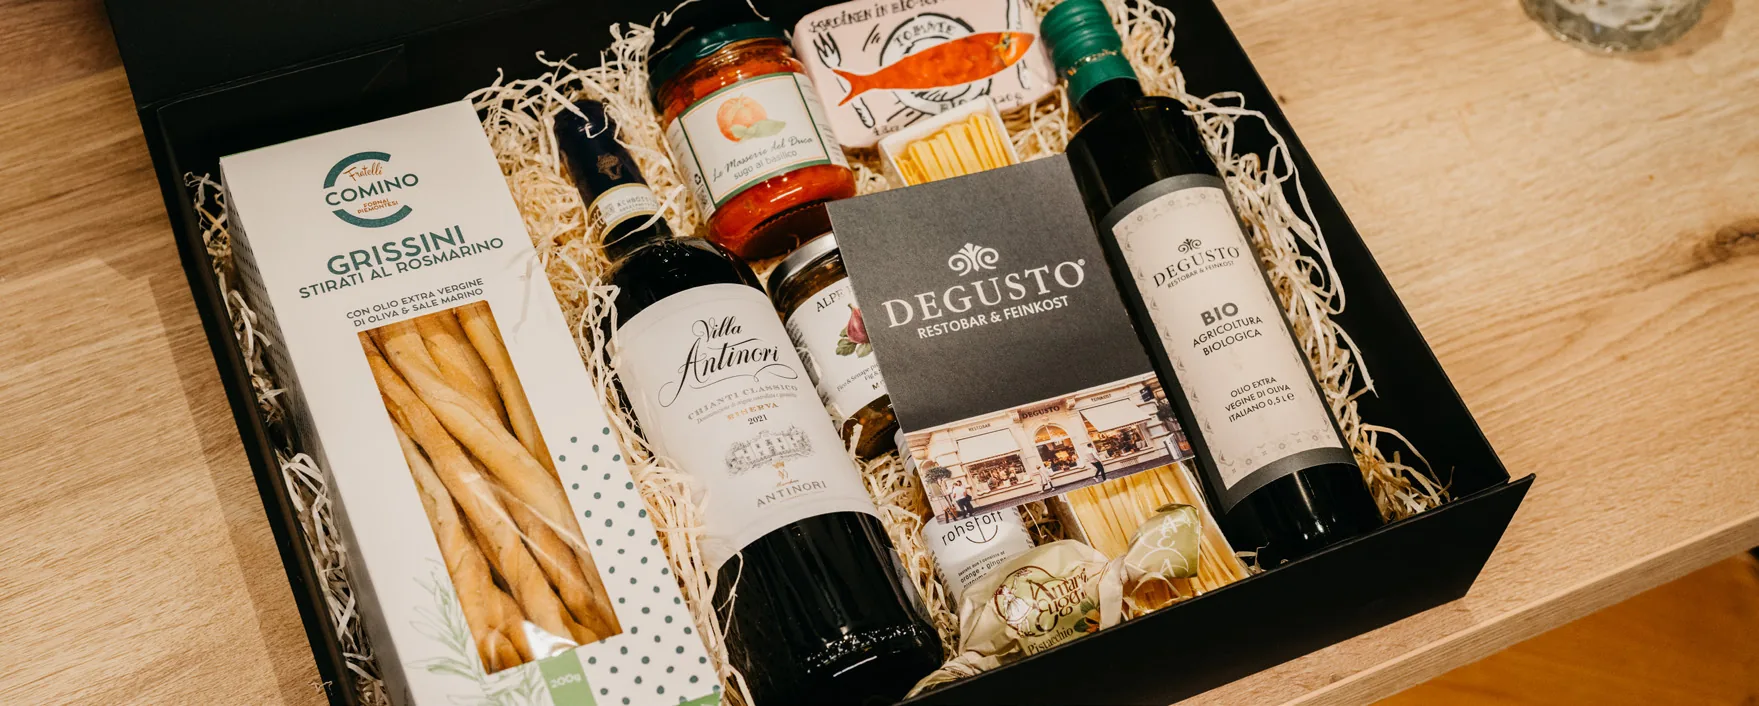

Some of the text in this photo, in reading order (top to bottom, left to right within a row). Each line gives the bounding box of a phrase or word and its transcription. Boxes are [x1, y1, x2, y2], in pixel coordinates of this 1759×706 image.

[893, 21, 957, 47] TOMATE
[725, 148, 768, 172] Masserie
[771, 138, 785, 152] del
[788, 136, 813, 147] Duca
[733, 149, 797, 180] sugo al basilico
[343, 162, 382, 181] Fratelli
[325, 173, 419, 206] COMINO
[363, 198, 389, 208] FORNAI
[357, 200, 399, 214] PIEMONTESI
[327, 225, 466, 275] GRISSINI
[299, 237, 504, 299] STIRATI AL ROSMARINO
[1167, 270, 1198, 288] RESTOBAR
[1205, 260, 1234, 271] FEINKOST
[346, 278, 484, 319] CON OLIO EXTRA VERGINE
[353, 288, 484, 327] DI OLIVA & SALE MARINO
[917, 295, 1069, 339] RESTOBAR & FEINKOST
[1200, 302, 1239, 326] BIO
[692, 316, 742, 342] Villa
[1193, 316, 1263, 348] AGRICOLTURA
[1202, 329, 1262, 356] BIOLOGICA
[658, 337, 779, 407] Antinori
[1225, 384, 1291, 412] VEGINE DI OLIVA
[1230, 376, 1277, 398] OLIO EXTRA
[688, 392, 739, 420] CHIANTI
[742, 384, 798, 396] CLASSICO
[727, 402, 779, 421] RISERVA
[1022, 405, 1060, 419] DEGUSTO
[1228, 401, 1266, 423] ITALIANO
[1267, 396, 1281, 405] 0,5
[748, 414, 768, 425] 2021
[757, 480, 827, 508] ANTINORI
[1027, 626, 1074, 655] Pistacchio
[551, 673, 582, 688] 200g
